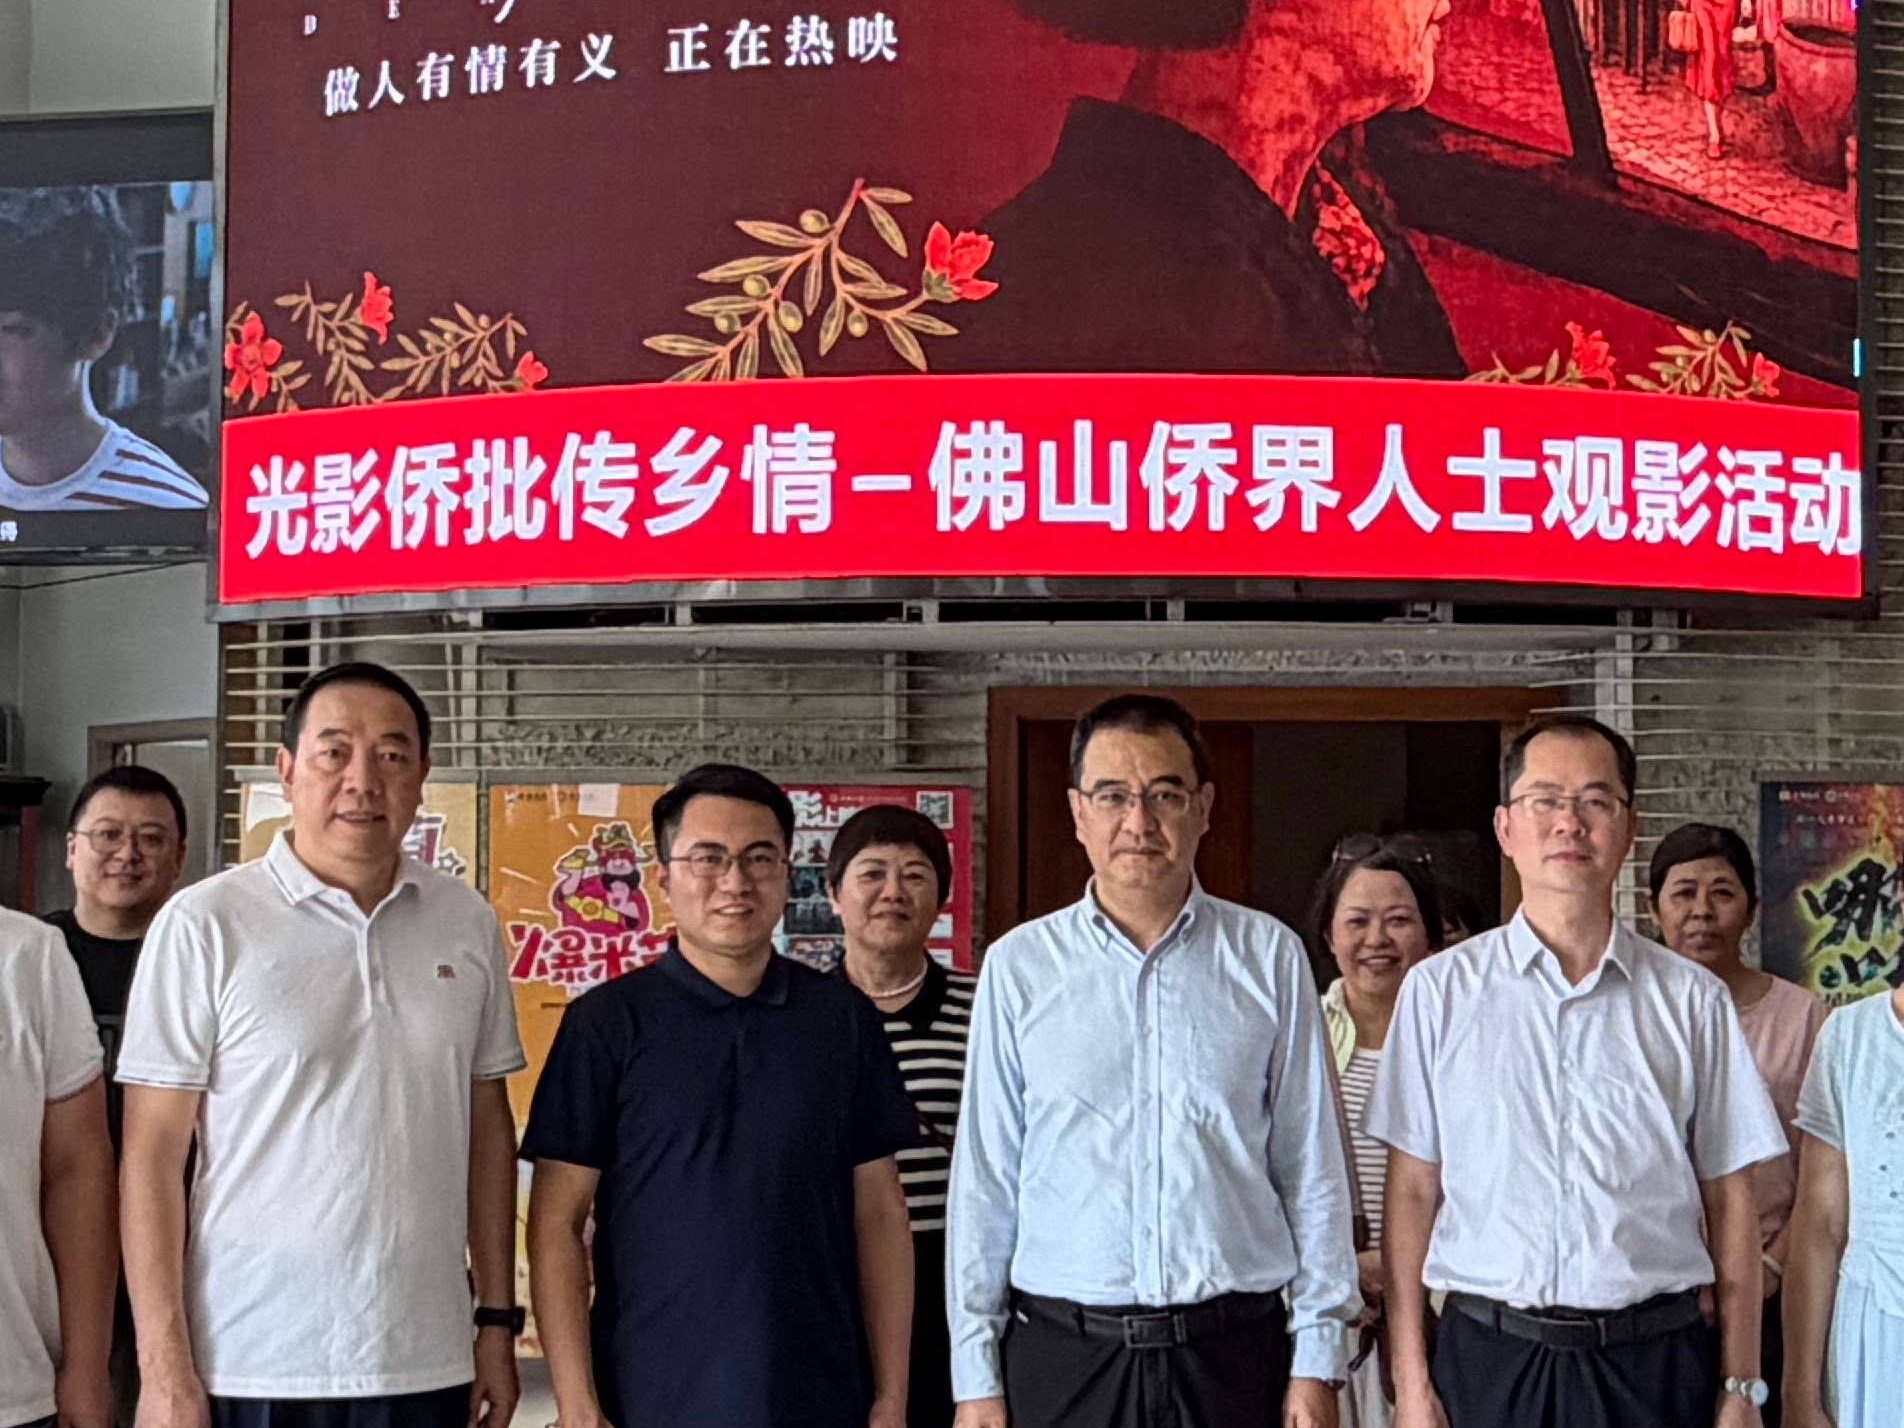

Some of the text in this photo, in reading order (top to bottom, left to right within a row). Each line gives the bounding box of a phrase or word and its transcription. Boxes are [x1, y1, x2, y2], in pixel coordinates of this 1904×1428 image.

[323, 11, 899, 117] 做人有情有义 正在热映
